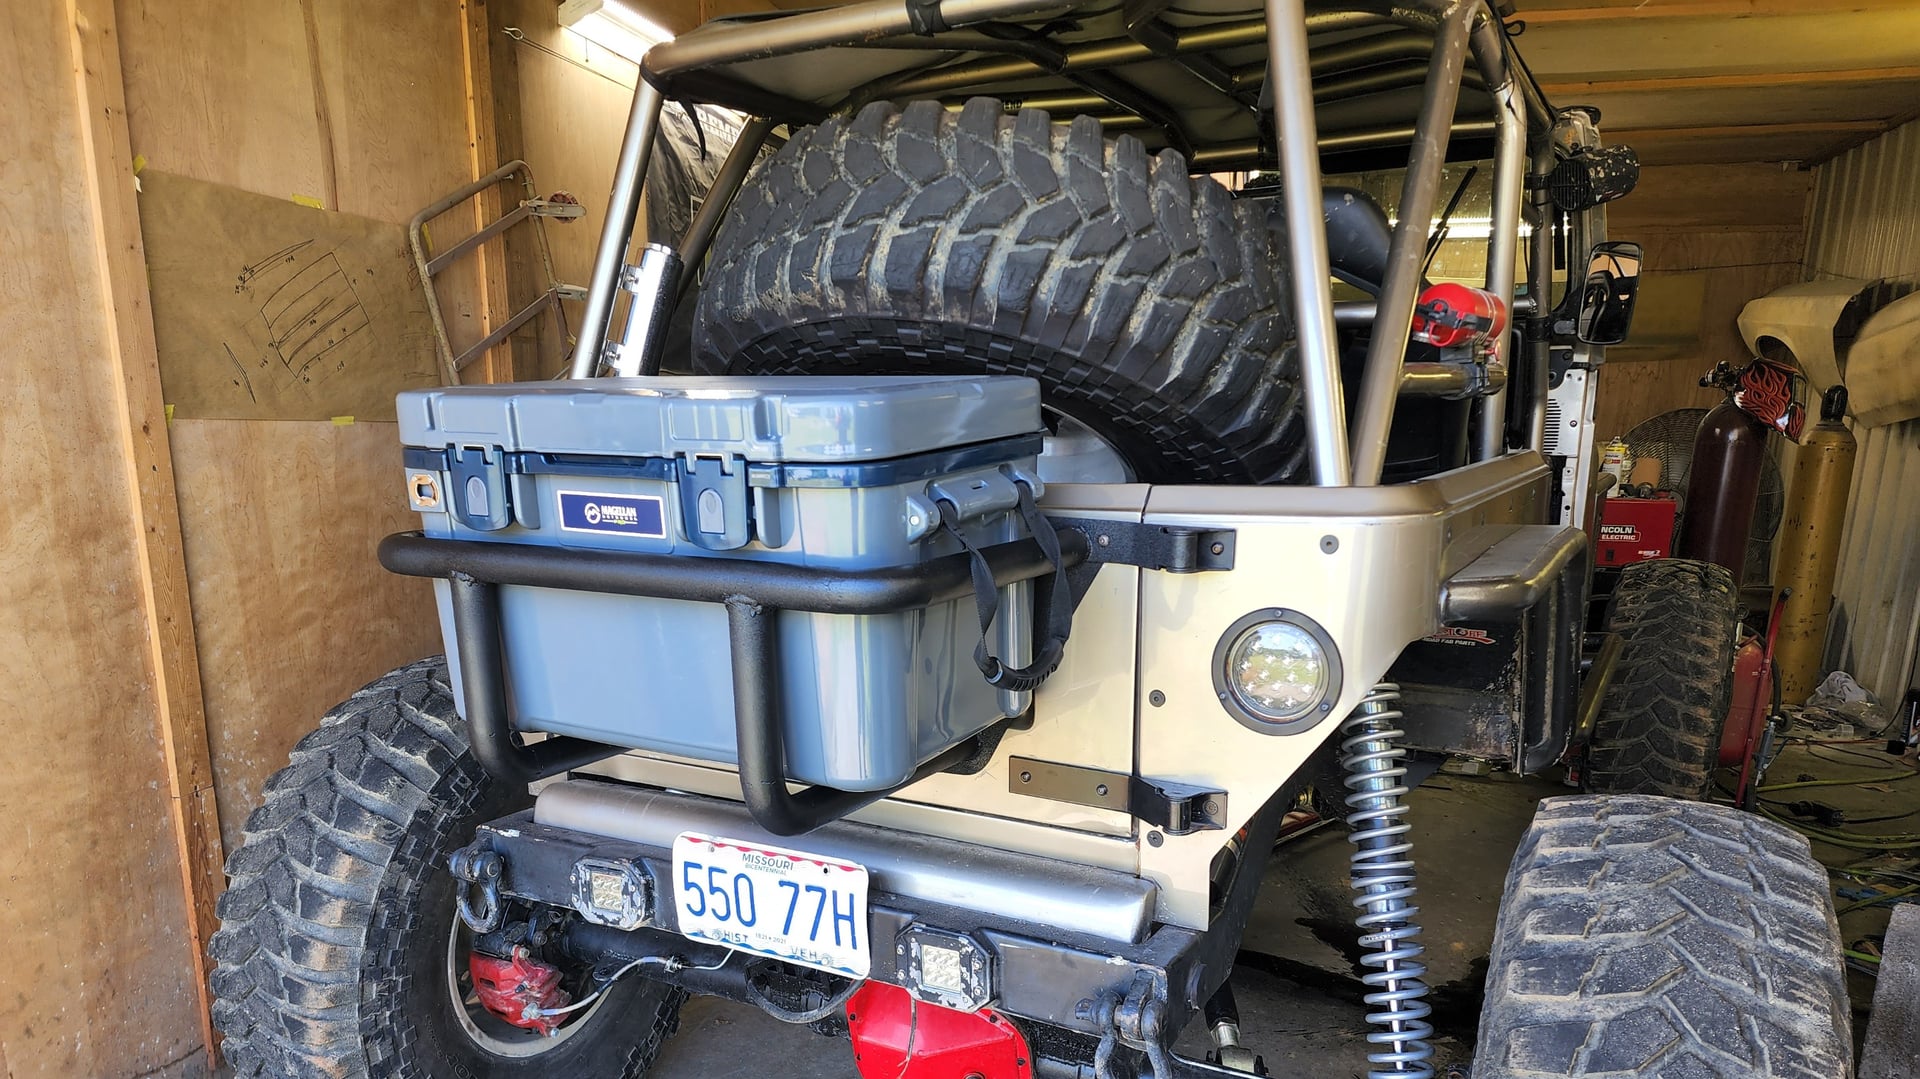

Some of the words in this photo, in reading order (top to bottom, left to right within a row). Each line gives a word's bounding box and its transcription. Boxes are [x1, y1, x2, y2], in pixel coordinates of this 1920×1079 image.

[601, 505, 637, 517] MAGELLAN
[1601, 526, 1633, 534] NCOLN
[742, 853, 794, 870] MISSOURI
[745, 863, 787, 876] BICENTENNIAL
[683, 861, 757, 928] 550
[778, 880, 858, 950] 77H
[723, 930, 749, 943] HIST
[791, 946, 817, 959] VEH
